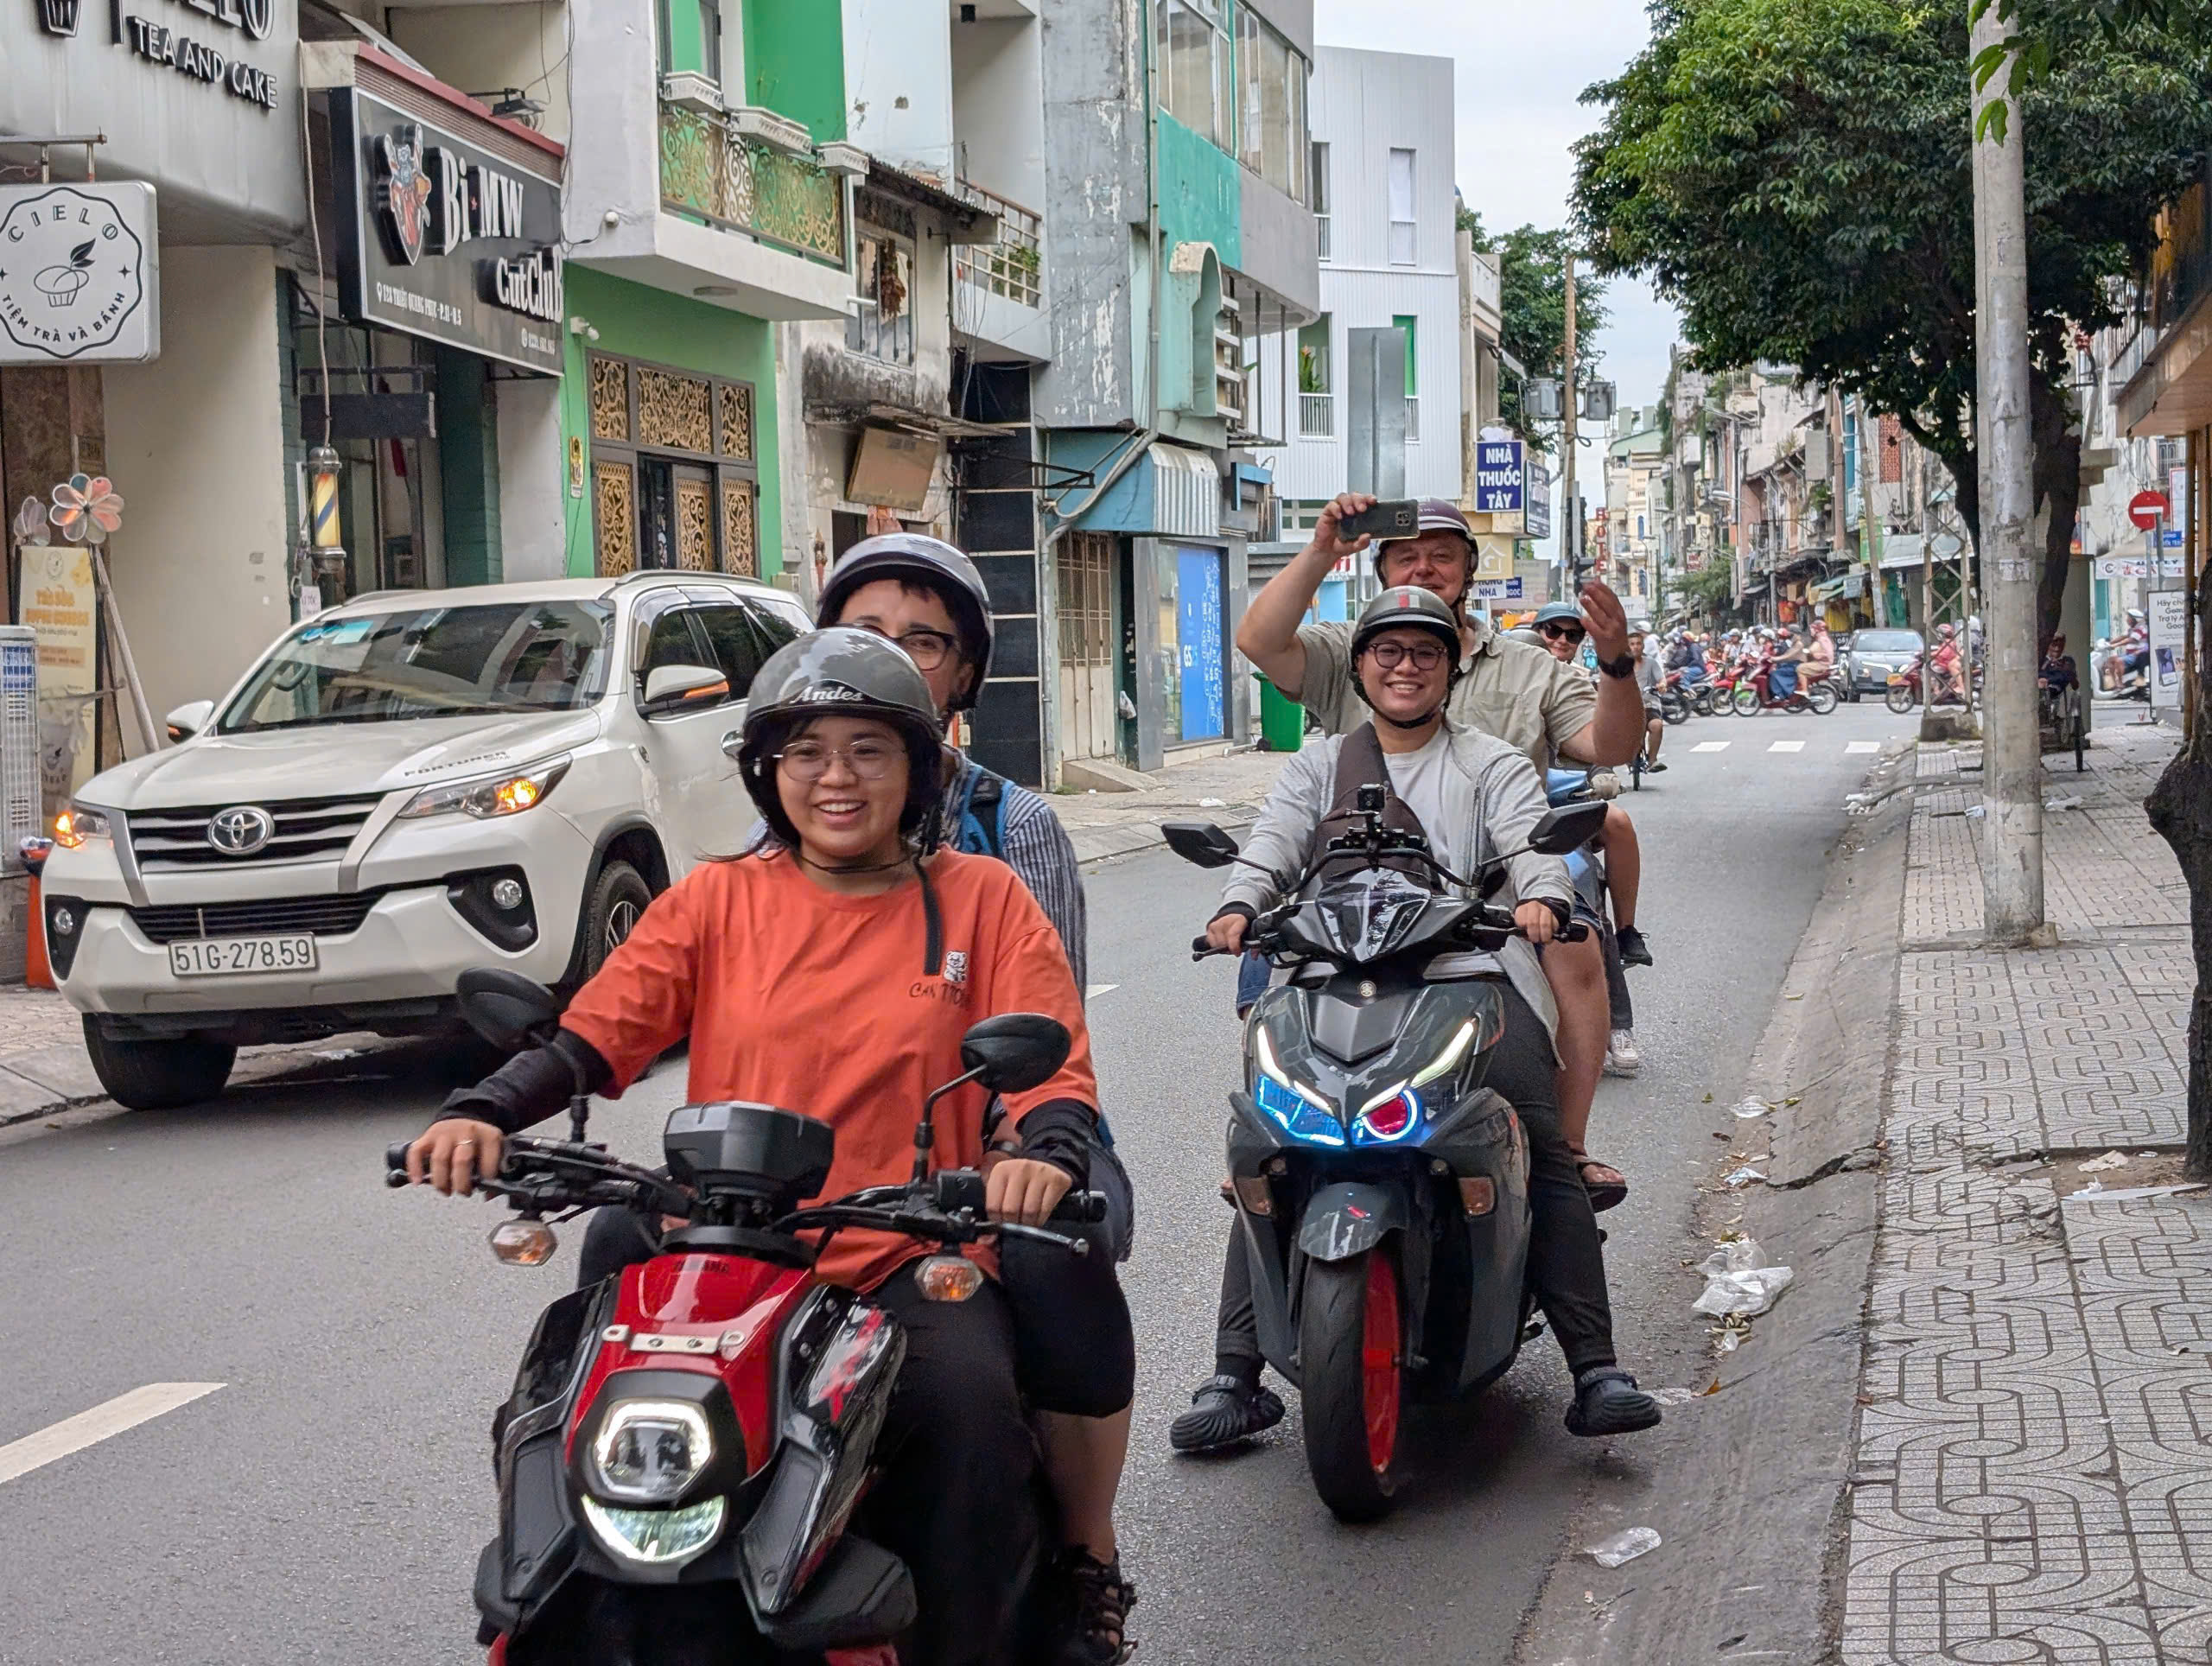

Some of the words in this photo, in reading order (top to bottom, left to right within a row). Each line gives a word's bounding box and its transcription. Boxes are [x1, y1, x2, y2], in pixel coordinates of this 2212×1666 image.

[134, 16, 176, 66] TEA
[184, 41, 225, 83] AND
[232, 61, 277, 108] CAKE
[8, 205, 118, 242] CIELO
[3, 295, 29, 329] TIỆM
[34, 327, 60, 342] TRÀ
[68, 326, 88, 341] VÀ
[92, 292, 125, 332] BÁNH
[1486, 443, 1513, 464] NHÀ
[1478, 464, 1521, 486] THUỐC
[1486, 490, 1513, 509] TÂY
[1595, 506, 1607, 575] HOTE
[789, 686, 864, 704] Andes
[404, 752, 505, 776] FORTUNER
[175, 938, 311, 971] 51G-278.59
